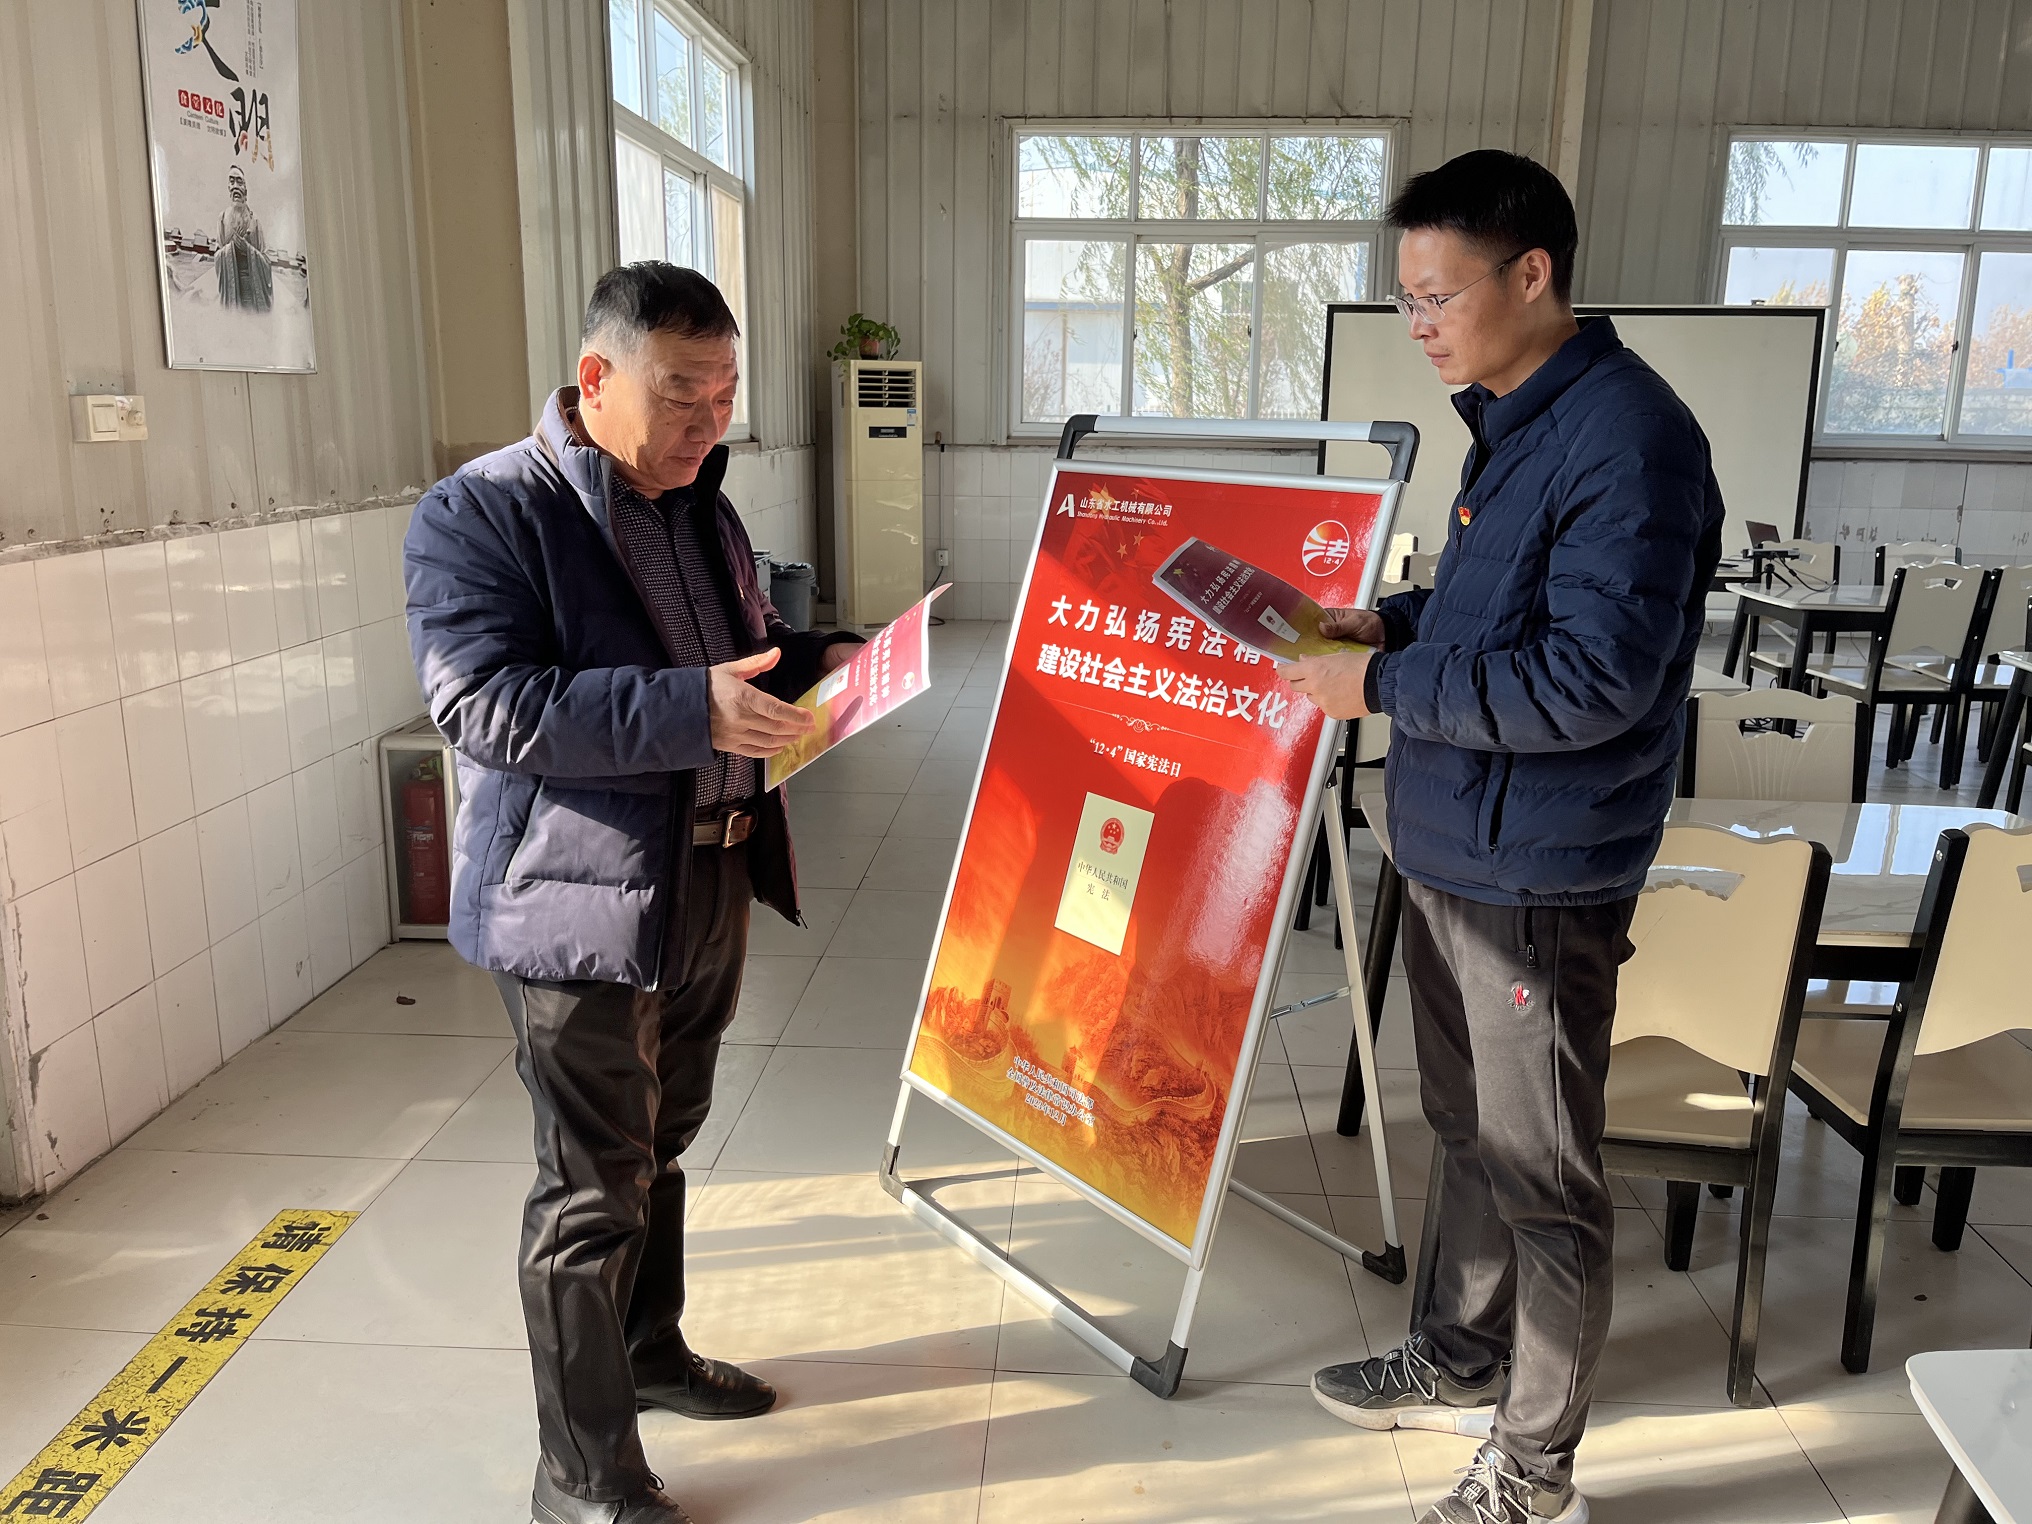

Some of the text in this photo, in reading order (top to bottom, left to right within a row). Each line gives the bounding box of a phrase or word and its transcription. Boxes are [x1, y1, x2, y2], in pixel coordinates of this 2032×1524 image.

[179, 90, 224, 117] 食堂文化
[1080, 497, 1173, 517] 山东省水工机械有限公司
[1121, 516, 1146, 525] Machinery
[1048, 595, 1280, 669] 大力弘扬宪法
[1036, 643, 1289, 730] 建设社会主义法治文化
[1078, 861, 1129, 890] 中华人民共和国
[1, 1220, 332, 1519] 请保持一米距
